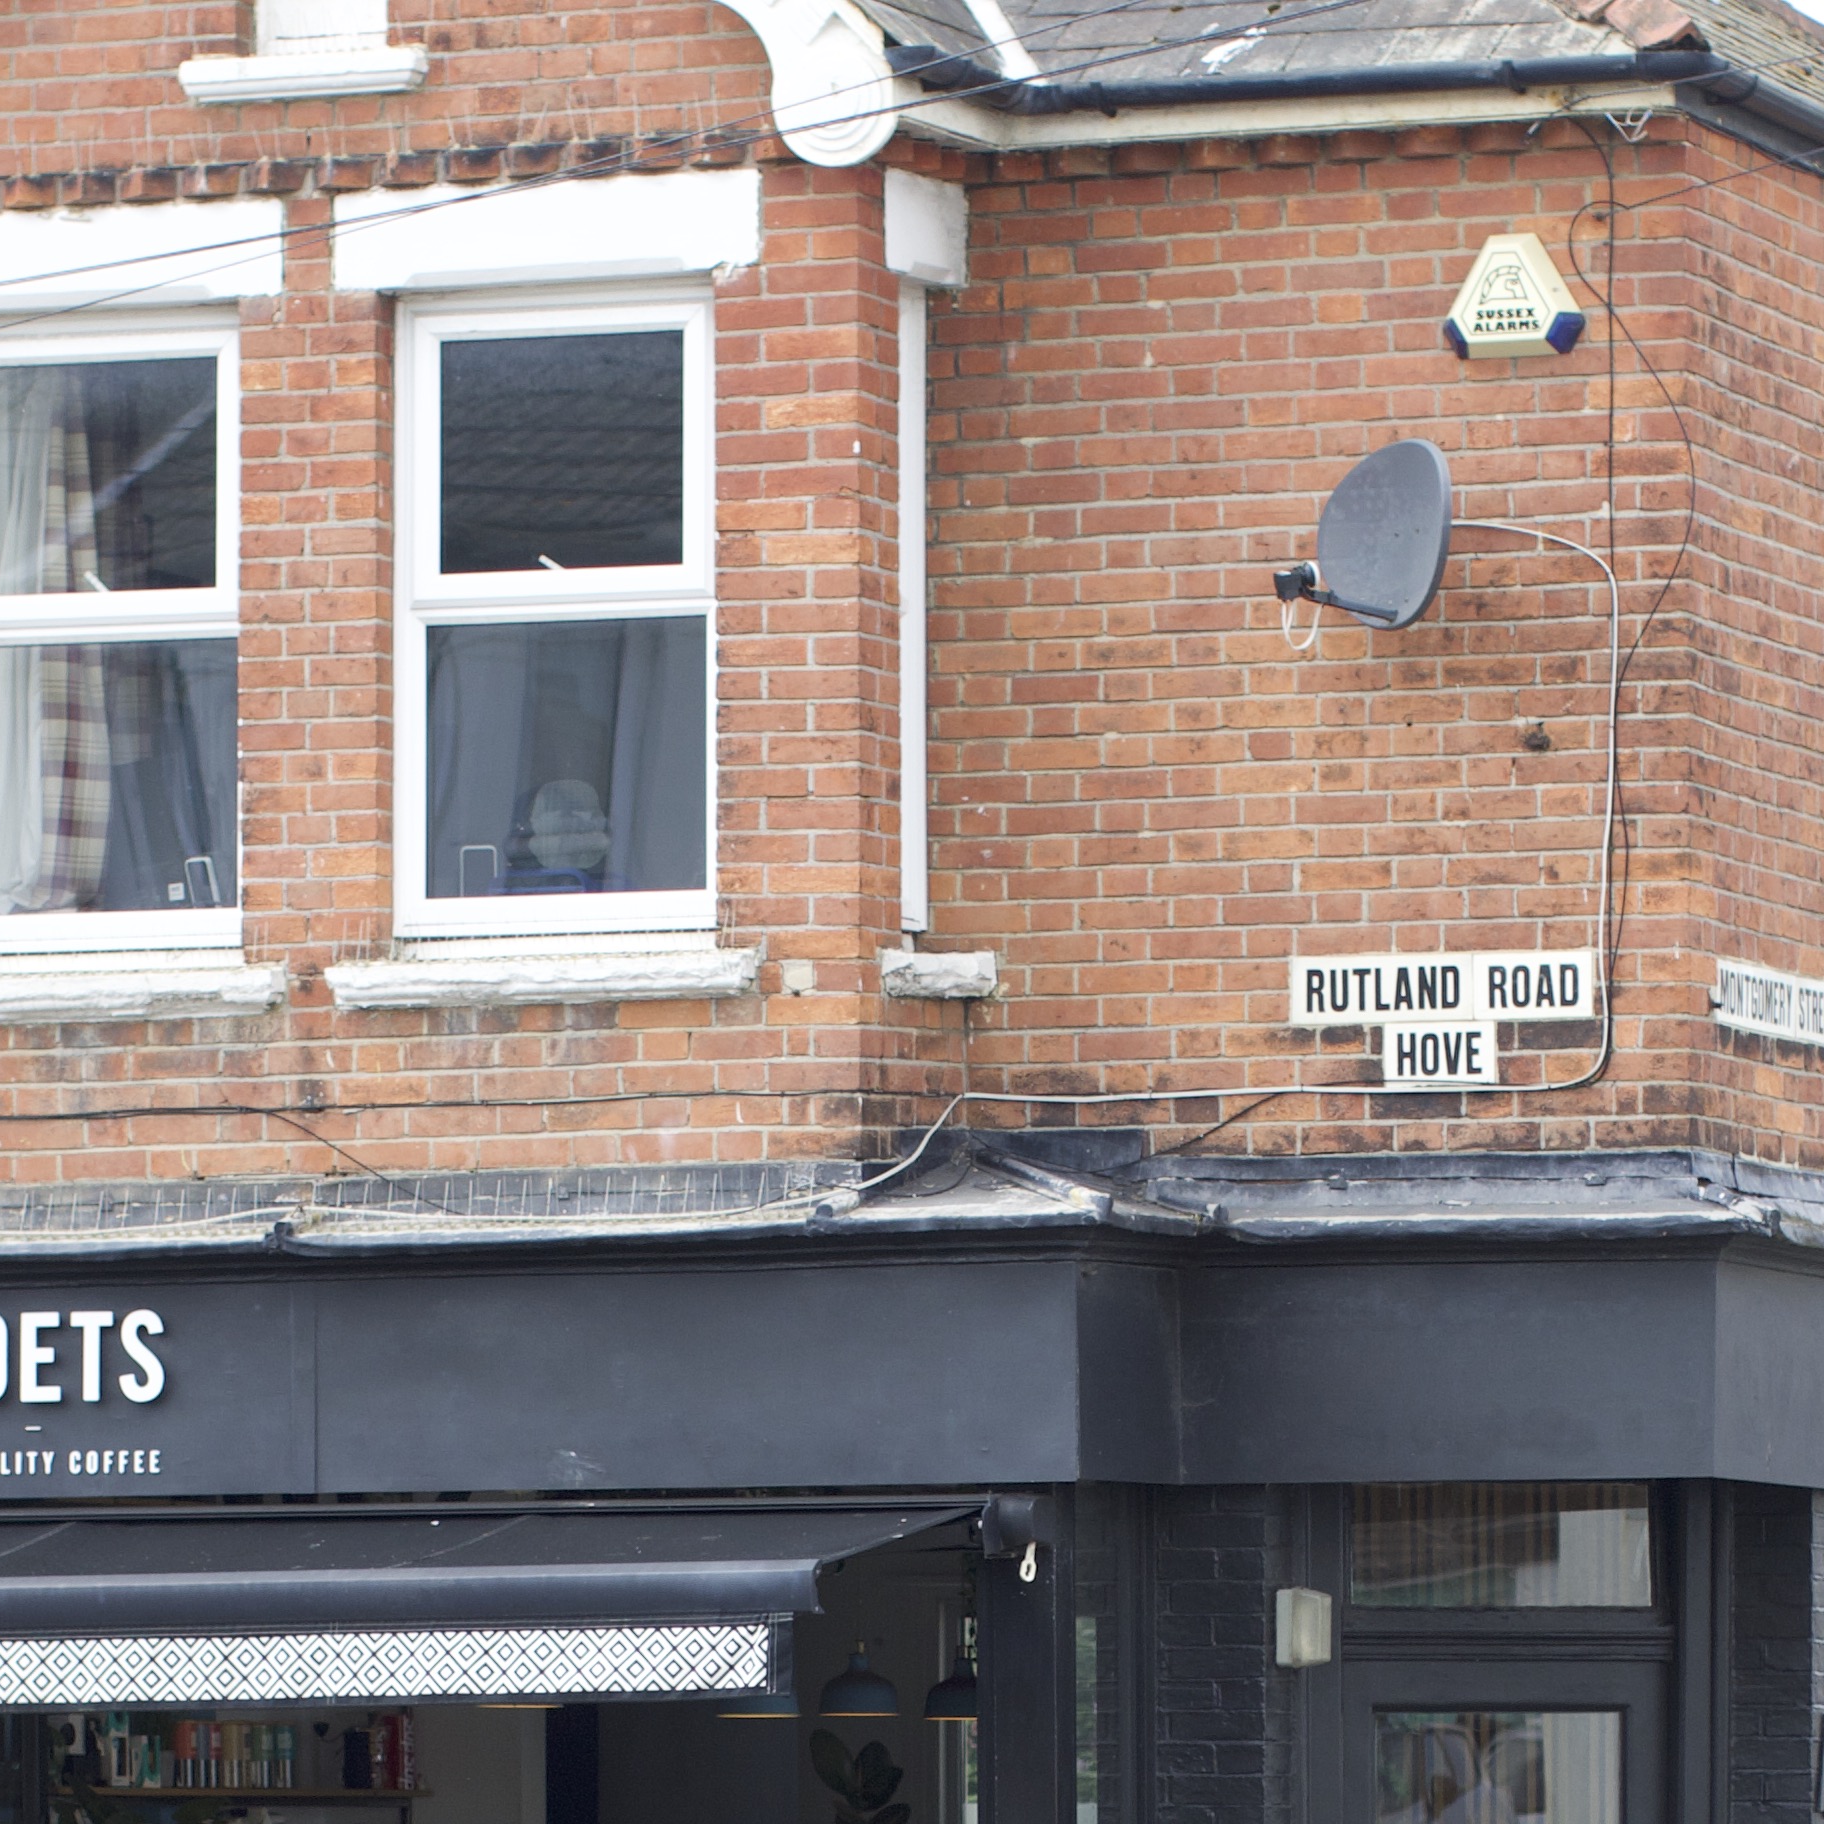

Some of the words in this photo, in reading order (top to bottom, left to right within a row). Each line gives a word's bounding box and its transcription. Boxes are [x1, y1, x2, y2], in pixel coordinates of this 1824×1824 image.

[1474, 320, 1540, 332] ALARMS
[1476, 308, 1535, 319] SUSSEX
[1305, 965, 1461, 1013] RUTLAND
[1488, 964, 1580, 1008] ROAD
[1720, 968, 1793, 1029] MONTGOMERY
[1396, 1030, 1483, 1076] HOVE
[68, 1449, 163, 1475] COFFEE
